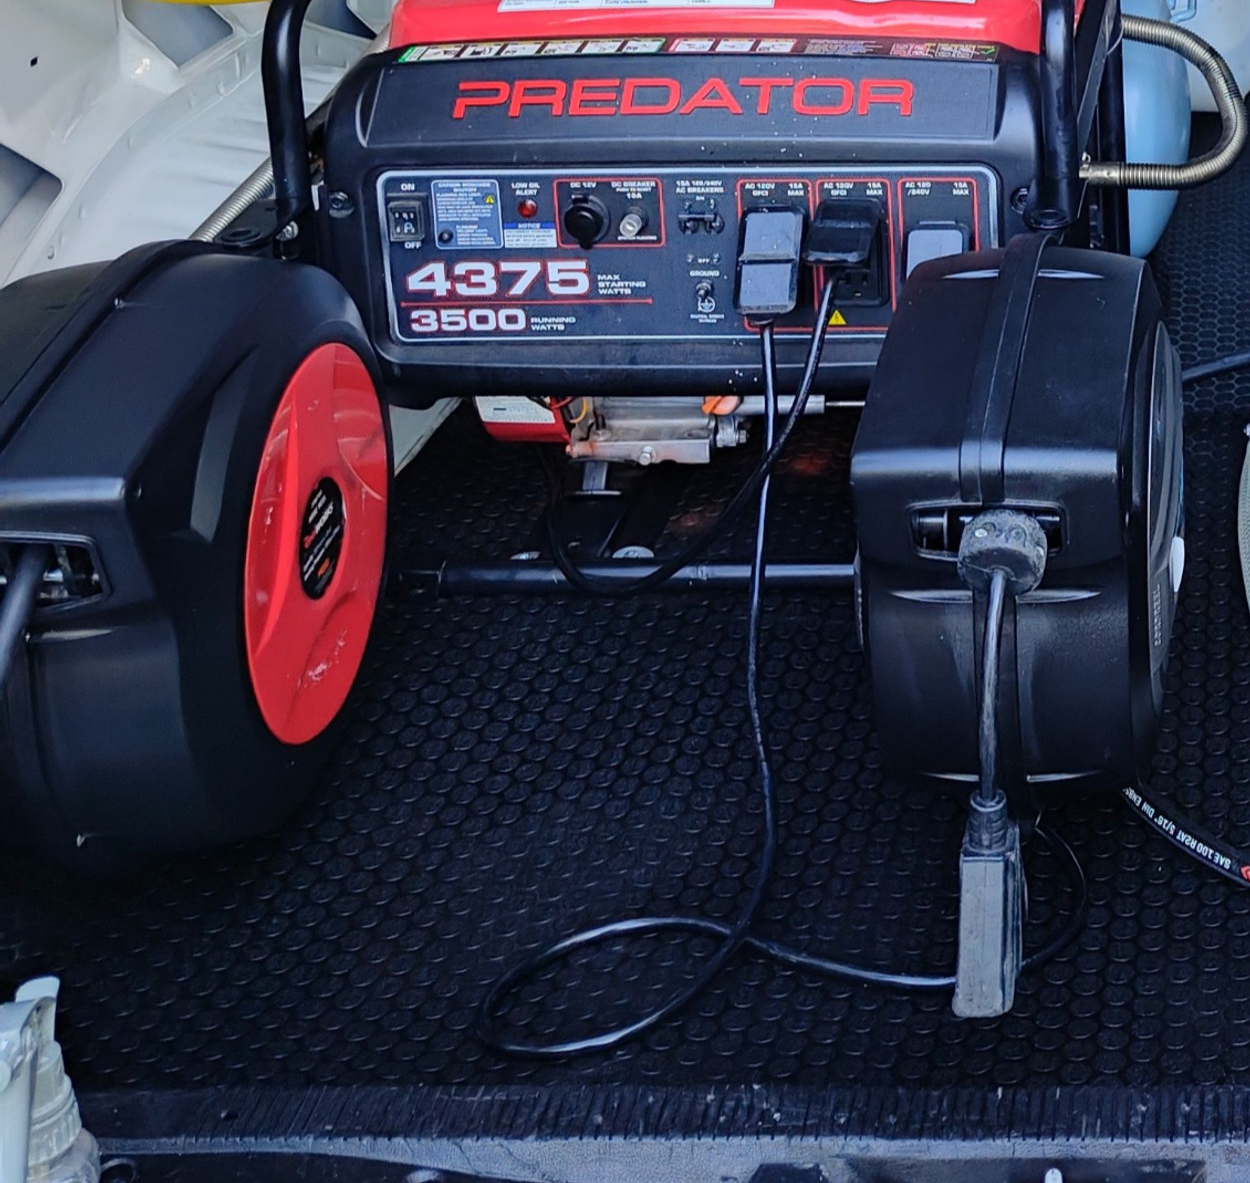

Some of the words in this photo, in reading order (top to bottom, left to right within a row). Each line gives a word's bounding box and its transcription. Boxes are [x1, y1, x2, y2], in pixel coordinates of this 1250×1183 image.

[453, 76, 915, 118] PREDATOR
[400, 183, 415, 191] ON
[515, 188, 538, 196] ALERT
[404, 241, 422, 249] OFF
[406, 261, 590, 296] 4375
[597, 280, 646, 288] STARTING
[410, 308, 527, 332] 3500
[1141, 801, 1156, 819] DIN
[1176, 830, 1198, 851] R2AT
[1196, 842, 1215, 860] 100
[1213, 852, 1232, 870] SAE
